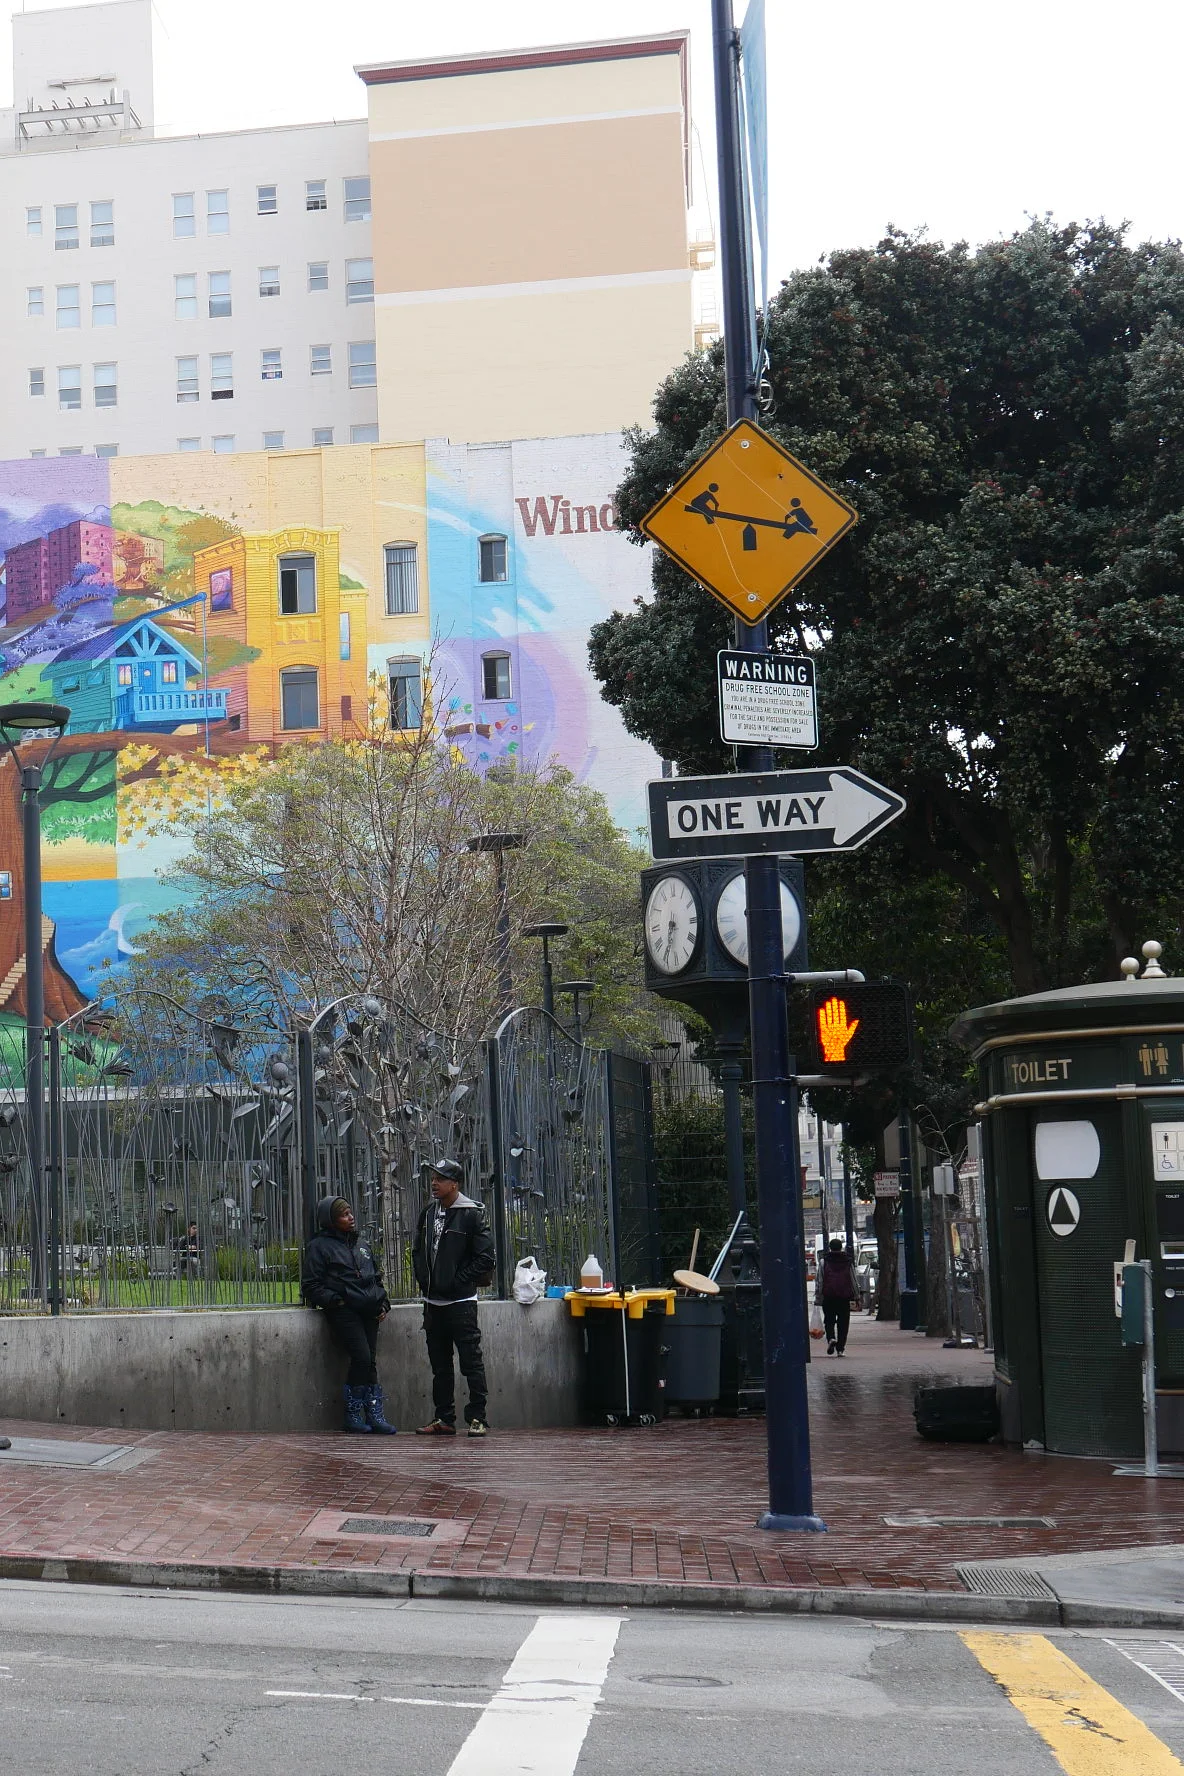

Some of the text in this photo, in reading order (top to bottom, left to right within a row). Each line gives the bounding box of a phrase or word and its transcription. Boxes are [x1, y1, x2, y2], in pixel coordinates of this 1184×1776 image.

[725, 659, 807, 683] WARNING
[725, 682, 810, 698] DRUG FREE SCHOOL ZONE
[677, 796, 826, 833] ONE WAY
[1011, 1058, 1073, 1084] TOILET
